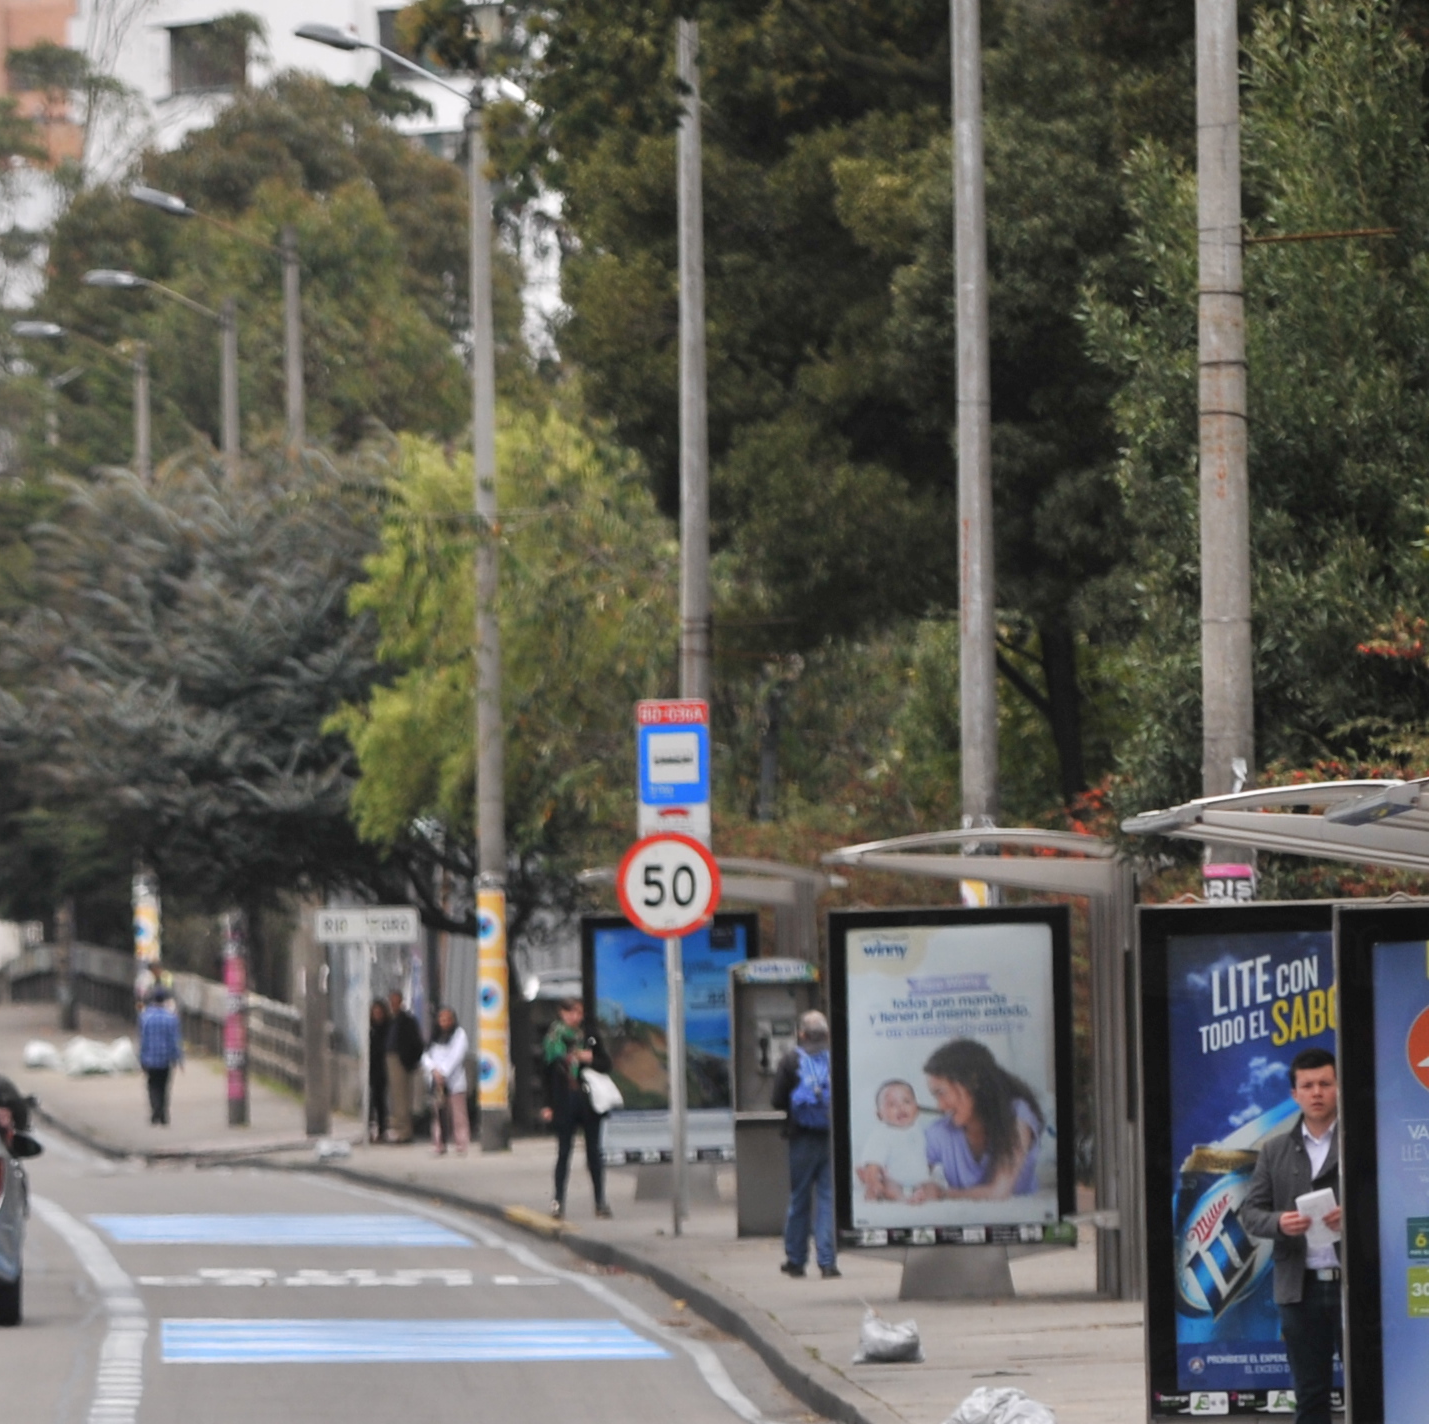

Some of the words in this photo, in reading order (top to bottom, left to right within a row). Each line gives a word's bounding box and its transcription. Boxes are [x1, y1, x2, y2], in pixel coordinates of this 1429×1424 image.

[643, 865, 698, 907] 50
[1211, 954, 1273, 1017] LITE
[1275, 955, 1319, 998] CON
[1198, 1014, 1246, 1054] TODO
[1249, 1009, 1270, 1040] EL
[1186, 1193, 1232, 1245] Miller
